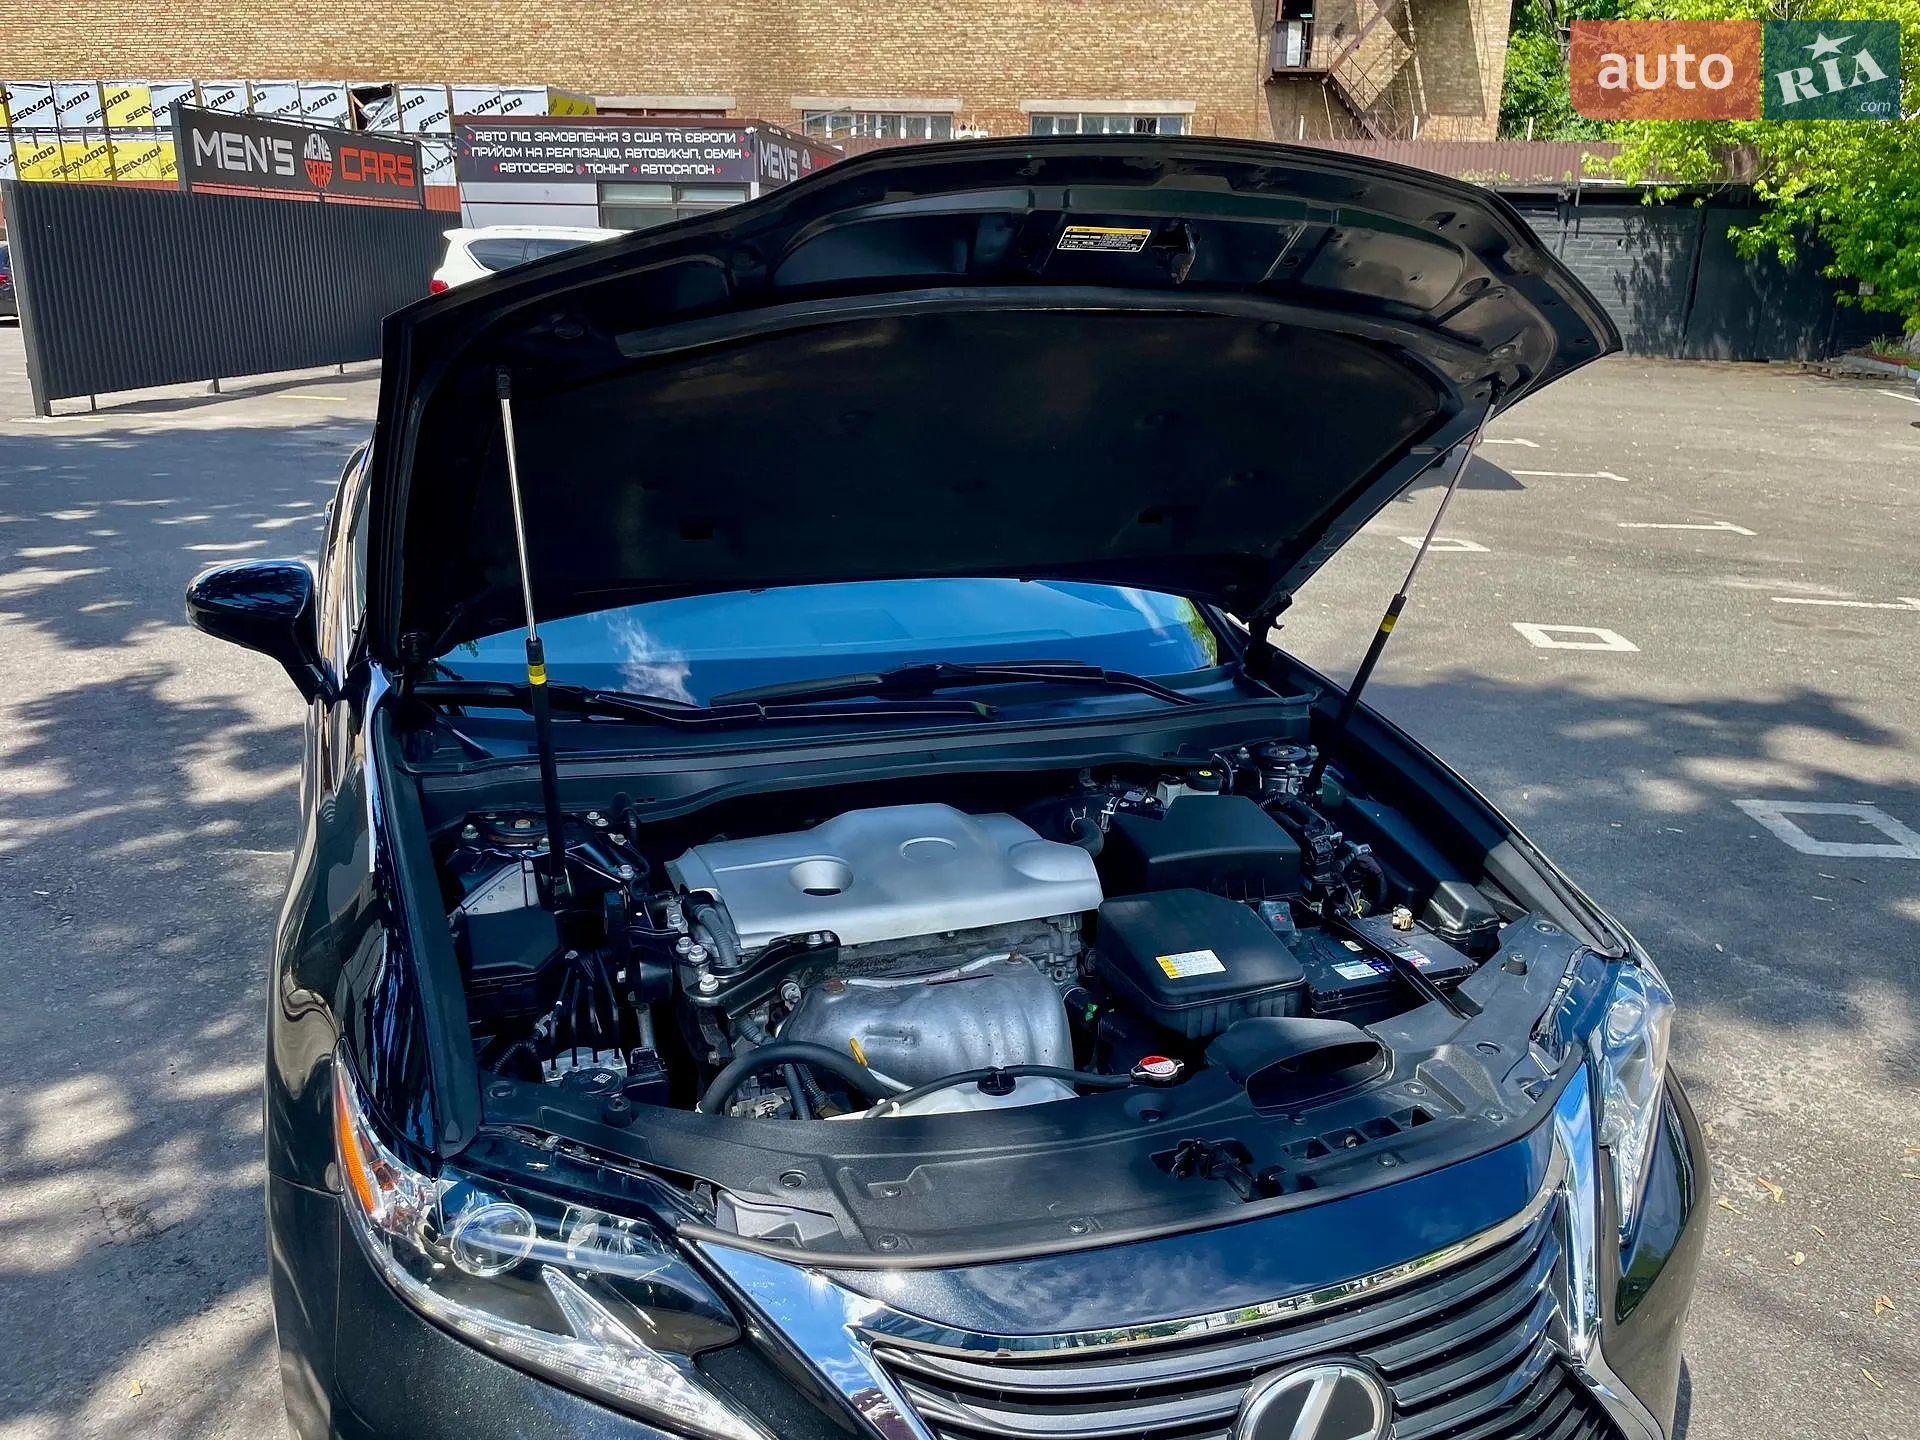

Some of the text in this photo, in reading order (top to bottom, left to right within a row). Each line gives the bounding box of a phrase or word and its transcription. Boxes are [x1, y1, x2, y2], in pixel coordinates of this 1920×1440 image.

[304, 133, 332, 161] MENS
[475, 131, 736, 143] АВТО ПІД ЗАМОВЛЕННЯ З США ТА ЄВРОПИ
[192, 127, 416, 187] MEN'S CARS
[471, 145, 522, 158] ПРИЙОМ
[525, 147, 543, 158] НА
[704, 148, 742, 159] ОБМІН
[759, 140, 799, 182] MEN'S
[304, 160, 333, 188] CARS
[499, 162, 715, 175] АВТОСЕРВІС ТЮНІНГ АВТОСАЛОН
